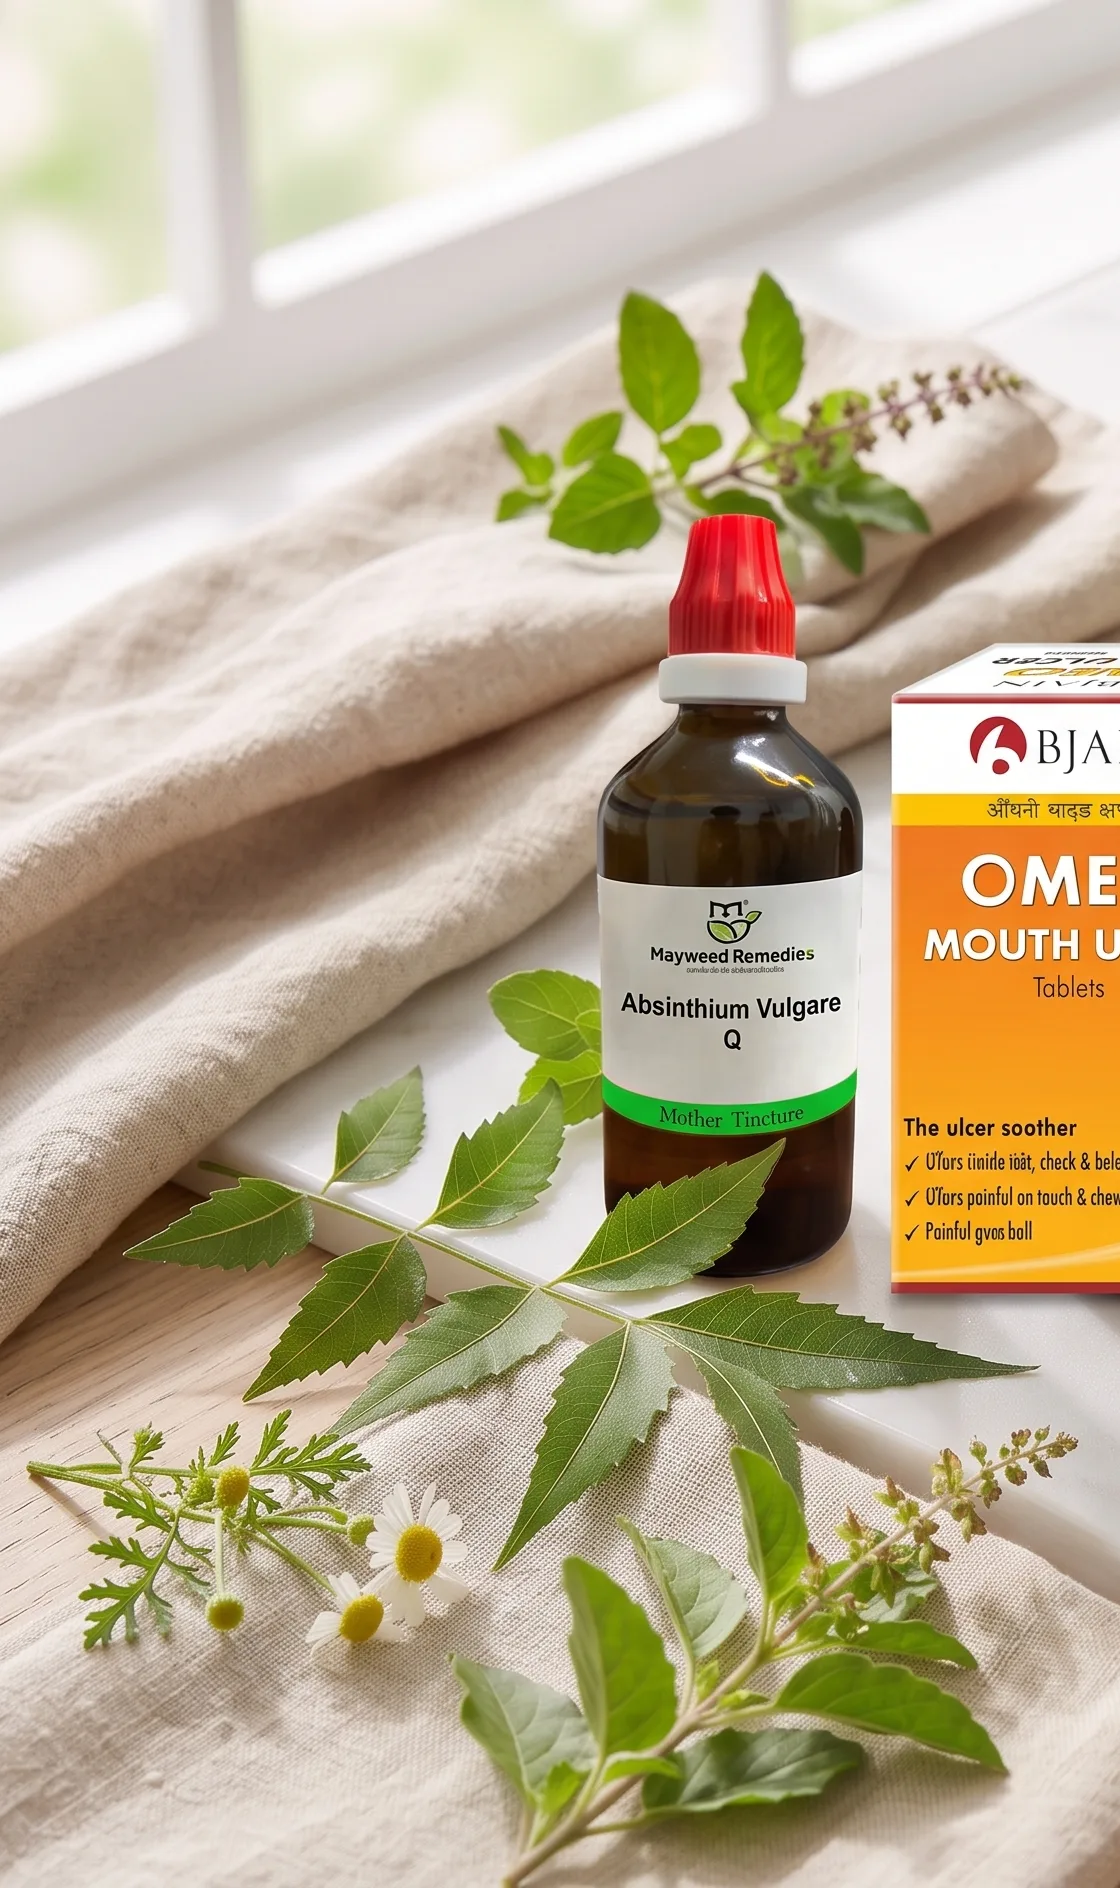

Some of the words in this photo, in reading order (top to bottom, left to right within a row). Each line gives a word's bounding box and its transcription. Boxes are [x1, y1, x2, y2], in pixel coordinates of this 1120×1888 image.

[923, 928, 1087, 962] MOUTH
[650, 946, 729, 966] Mayweed
[733, 946, 815, 964] Remedies
[1033, 976, 1105, 998] Tablets
[621, 992, 749, 1020] Absinthium
[756, 995, 842, 1022] Vulgare
[723, 1029, 742, 1051] Q
[659, 1105, 723, 1128] Mother
[731, 1107, 804, 1128] Tincture
[904, 1117, 939, 1137] The
[946, 1117, 995, 1137] ulcer
[1001, 1117, 1077, 1137] soother
[1040, 1150, 1076, 1170] check
[1080, 1152, 1091, 1170] &
[1017, 1192, 1033, 1206] on
[1076, 1187, 1087, 1206] &
[925, 1220, 971, 1240] Painful
[1008, 1220, 1033, 1240] ball
